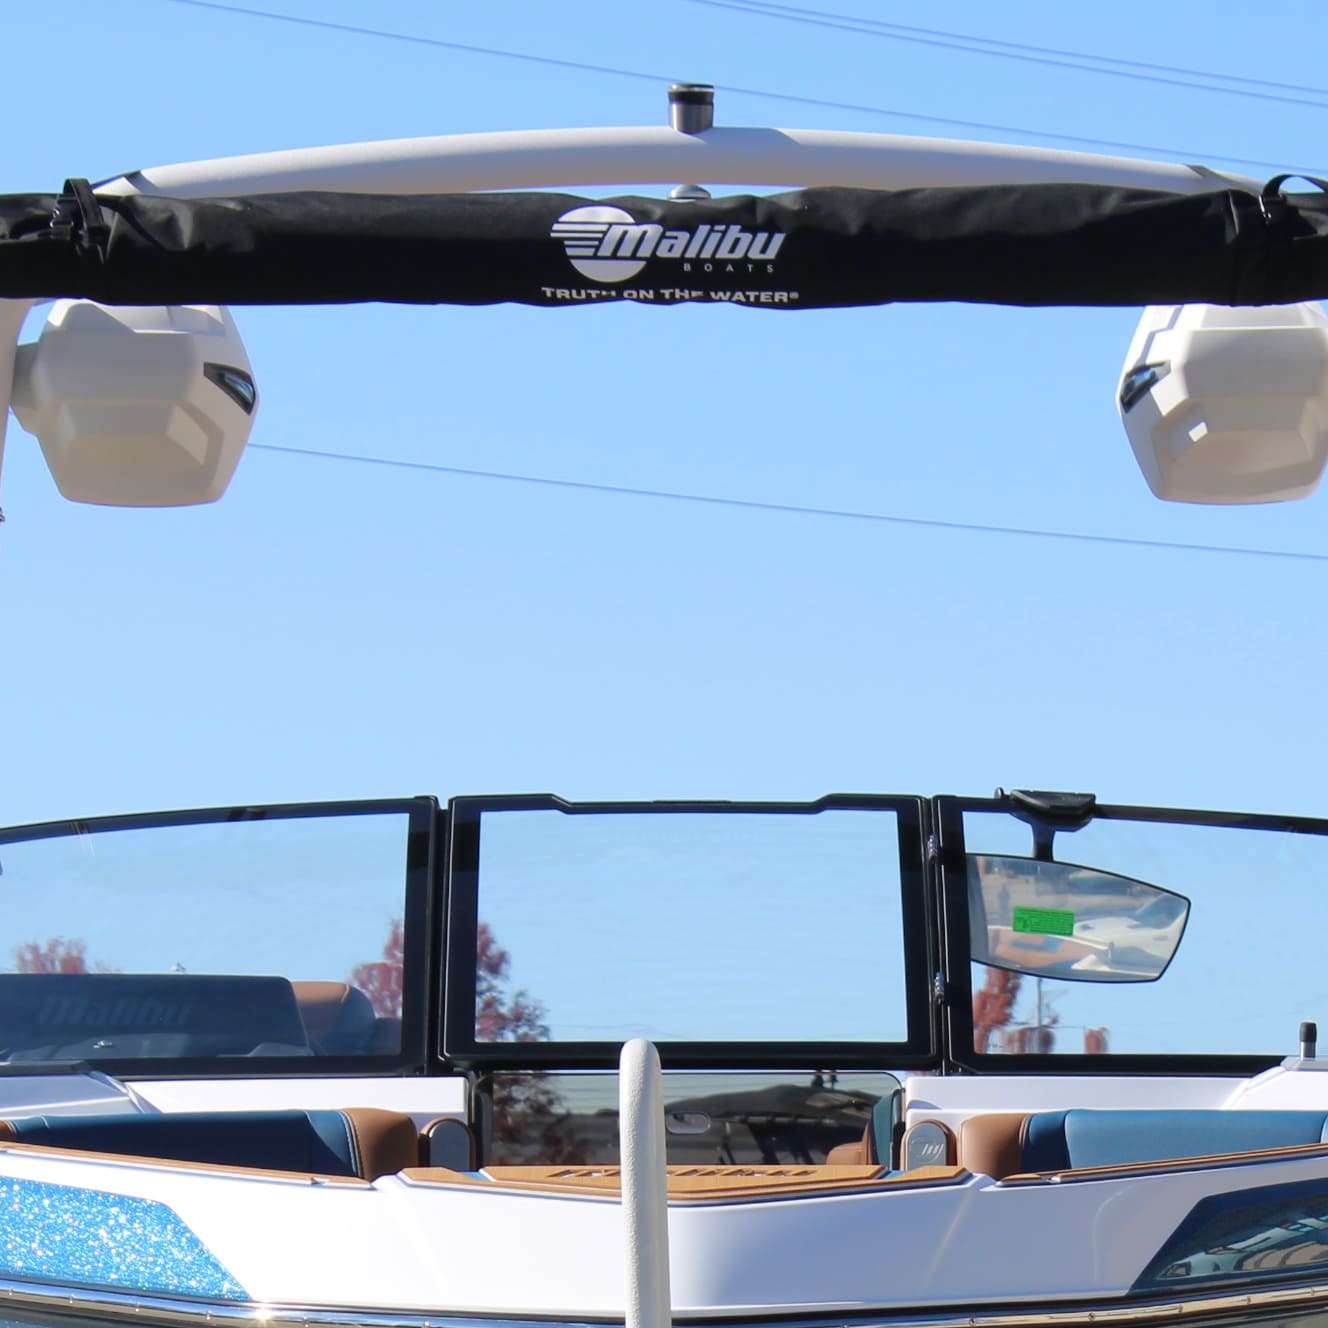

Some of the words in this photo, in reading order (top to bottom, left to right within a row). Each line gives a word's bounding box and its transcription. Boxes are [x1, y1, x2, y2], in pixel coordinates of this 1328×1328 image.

[597, 224, 785, 259] Malibu
[684, 262, 774, 273] BOATS
[623, 289, 654, 299] ON
